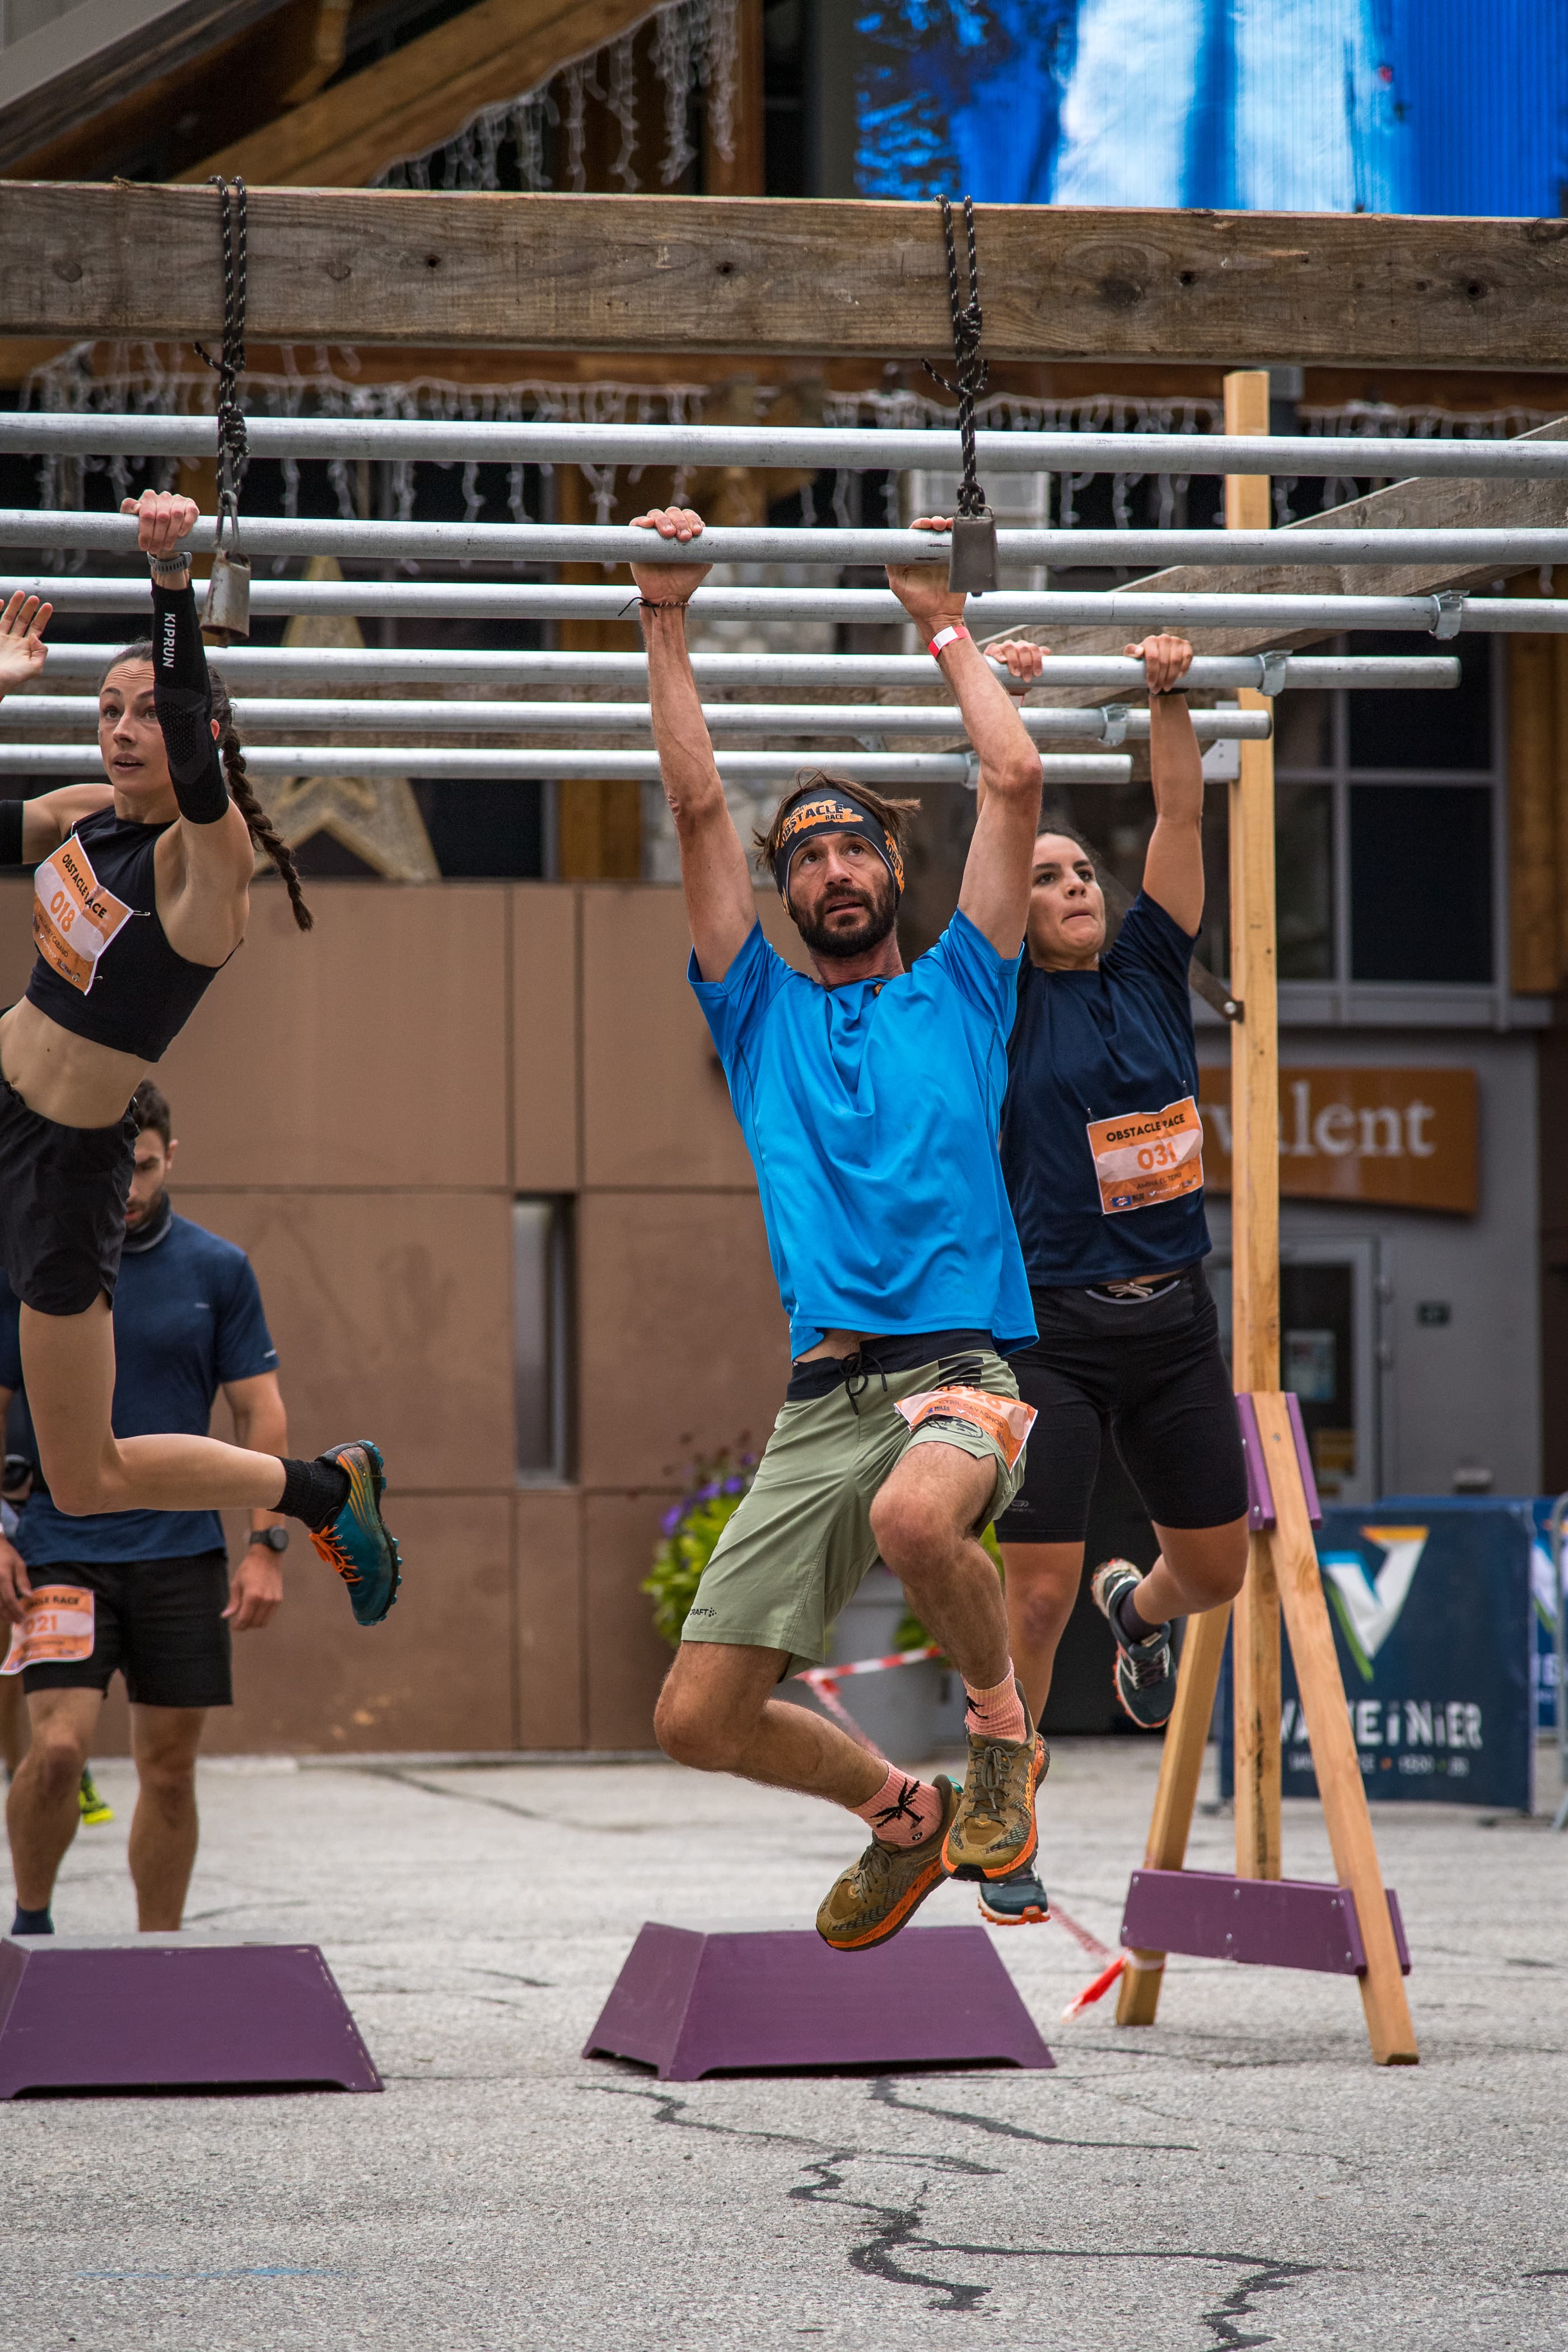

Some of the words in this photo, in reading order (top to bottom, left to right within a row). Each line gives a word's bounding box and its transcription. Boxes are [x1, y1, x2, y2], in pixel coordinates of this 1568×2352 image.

[162, 612, 176, 668] KIPRUN
[62, 854, 89, 897] OBSTACLE
[50, 890, 76, 932] 018
[1106, 1121, 1161, 1142] OBSTACLE
[1137, 1142, 1177, 1170] 031
[53, 1596, 79, 1605] RACE
